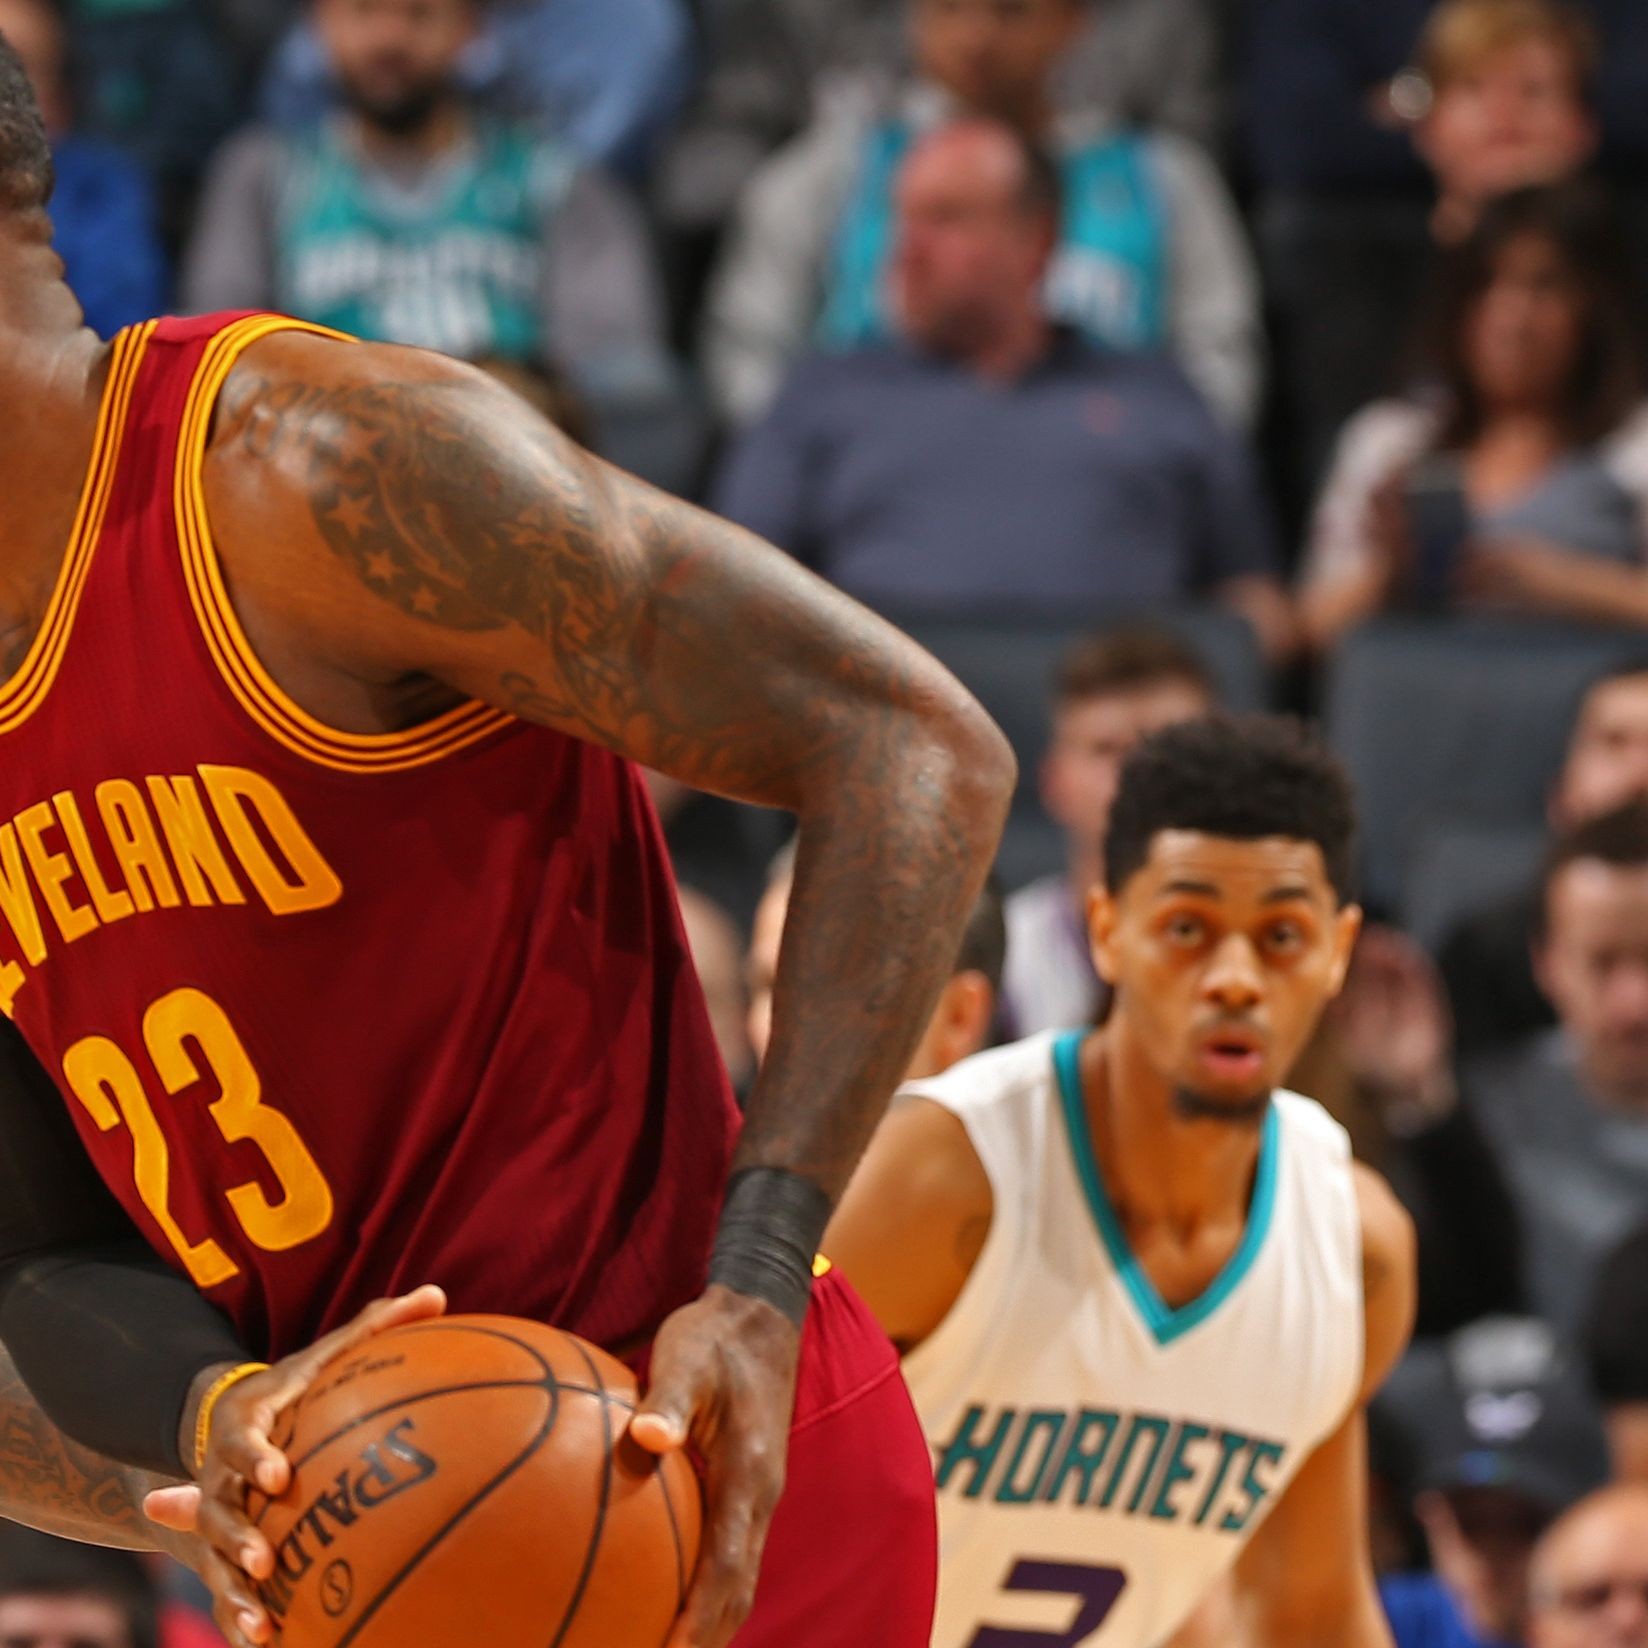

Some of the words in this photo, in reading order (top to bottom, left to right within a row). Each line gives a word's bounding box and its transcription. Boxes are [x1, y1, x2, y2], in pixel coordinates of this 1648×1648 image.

[62, 988, 333, 1287] 23
[258, 1417, 437, 1632] SPALDIN
[934, 1403, 1288, 1532] HORNETS
